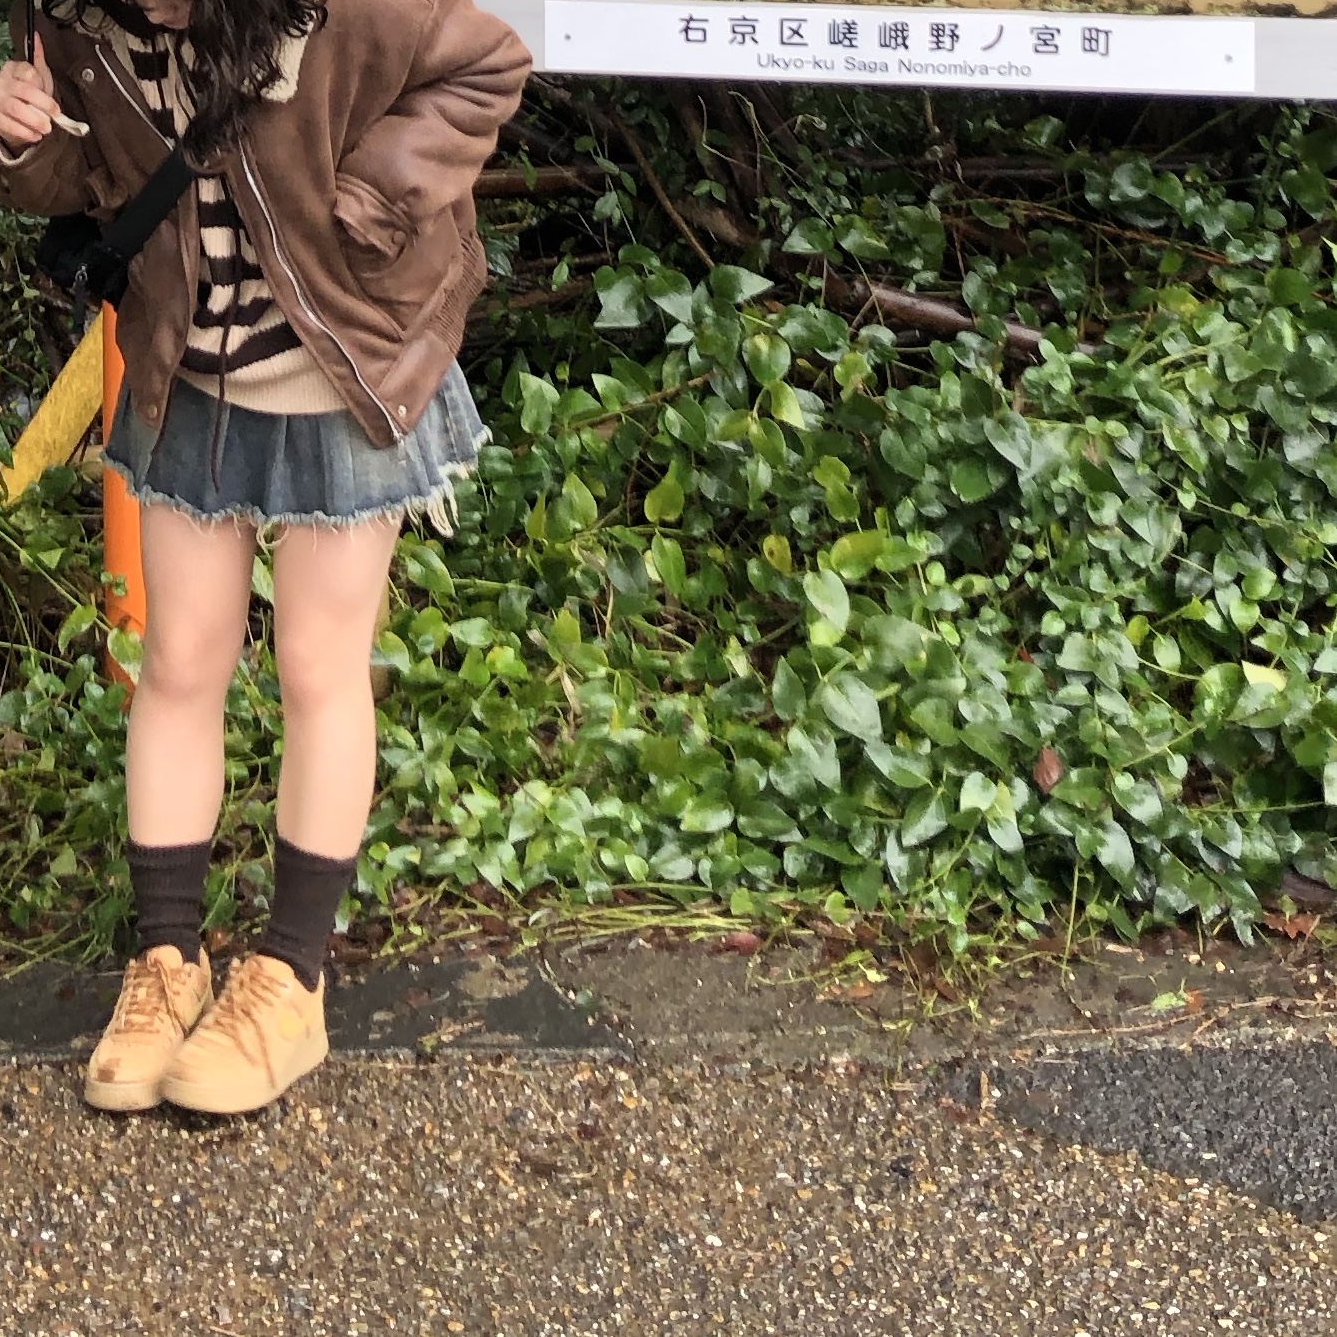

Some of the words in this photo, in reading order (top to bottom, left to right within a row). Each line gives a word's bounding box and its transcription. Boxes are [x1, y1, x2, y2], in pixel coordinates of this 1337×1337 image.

[678, 13, 1113, 57] 右京区嵯峨野ノ宮町
[756, 53, 835, 71] Ukyo-ku
[844, 55, 889, 73] Saga
[897, 57, 1032, 78] Nonomiya-cho
